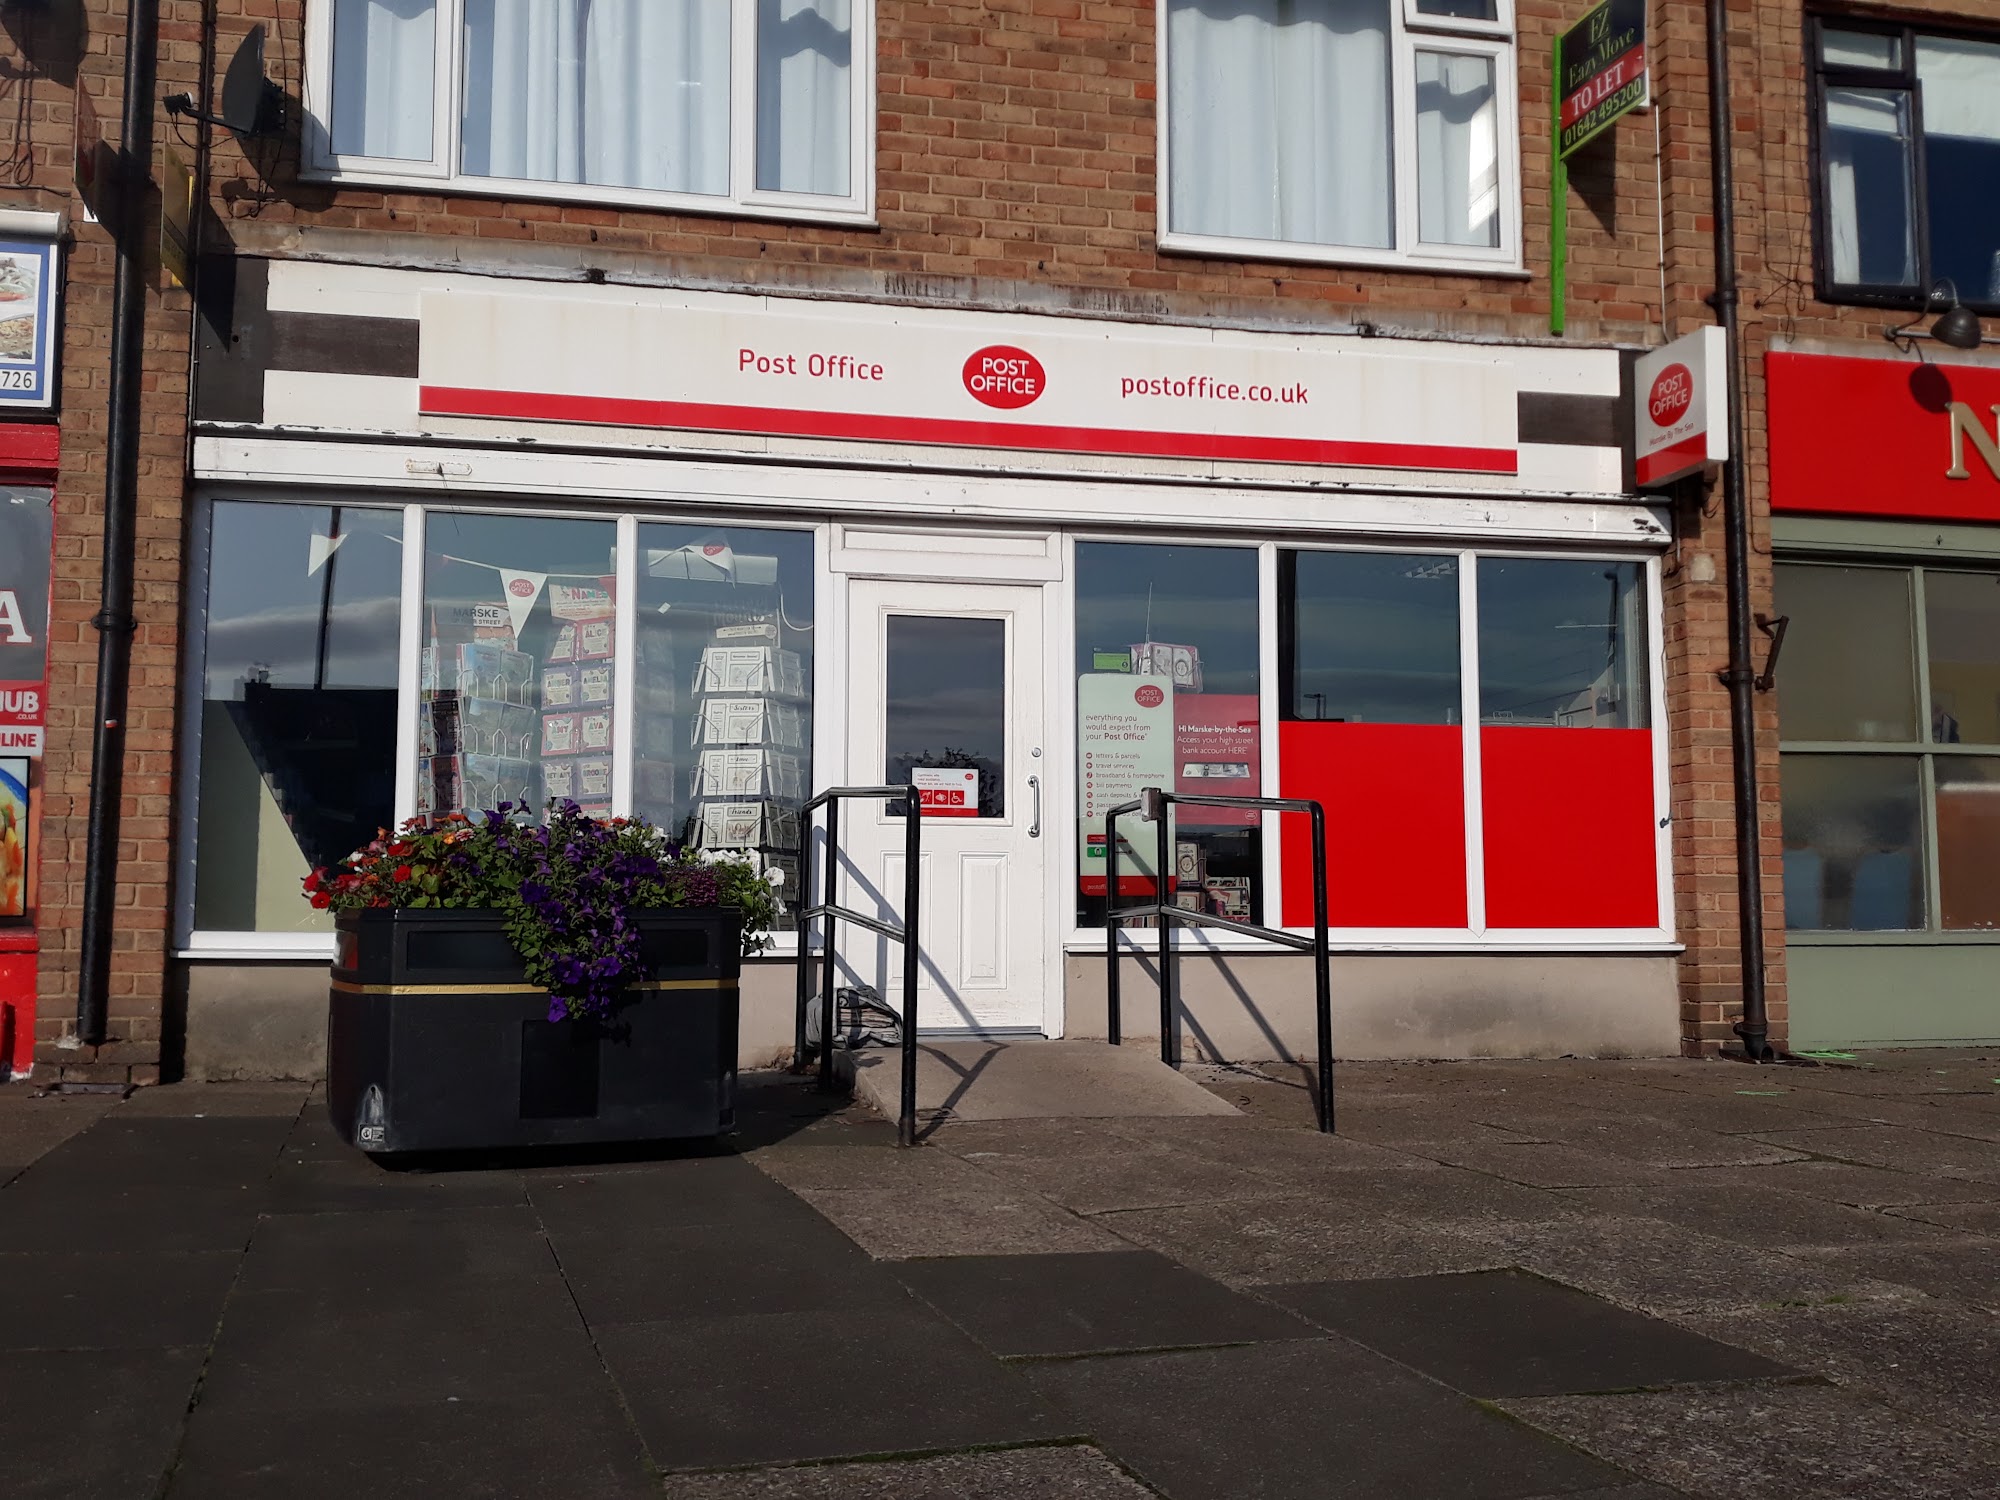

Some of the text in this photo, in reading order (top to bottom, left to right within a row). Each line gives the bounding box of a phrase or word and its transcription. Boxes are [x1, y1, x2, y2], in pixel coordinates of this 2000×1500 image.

[1600, 27, 1634, 61] Move
[1572, 61, 1624, 116] TO LET
[1565, 77, 1642, 146] 01642 495200
[739, 348, 883, 381] Post Office
[982, 357, 1030, 376] POST
[2, 371, 32, 389] 726
[970, 374, 1036, 395] OFFICE
[1658, 372, 1685, 397] POST
[1121, 376, 1308, 404] postoffice.co.uk
[1652, 388, 1687, 416] OFFICE
[1944, 401, 2000, 483] N
[510, 586, 531, 594] OFFICE
[453, 608, 499, 618] MARSKE
[0, 690, 39, 713] UB
[1137, 695, 1160, 703] OFFICE
[1085, 714, 1138, 723] everything you
[1085, 723, 1151, 732] would expect from
[1085, 733, 1102, 741] your
[1104, 732, 1121, 740] Post
[1188, 724, 1251, 735] Marske-by-the-Sea
[0, 732, 37, 748] LINE
[1176, 735, 1201, 743] Access
[1202, 737, 1217, 745] your
[1219, 735, 1233, 746] high
[1182, 745, 1199, 754] bank
